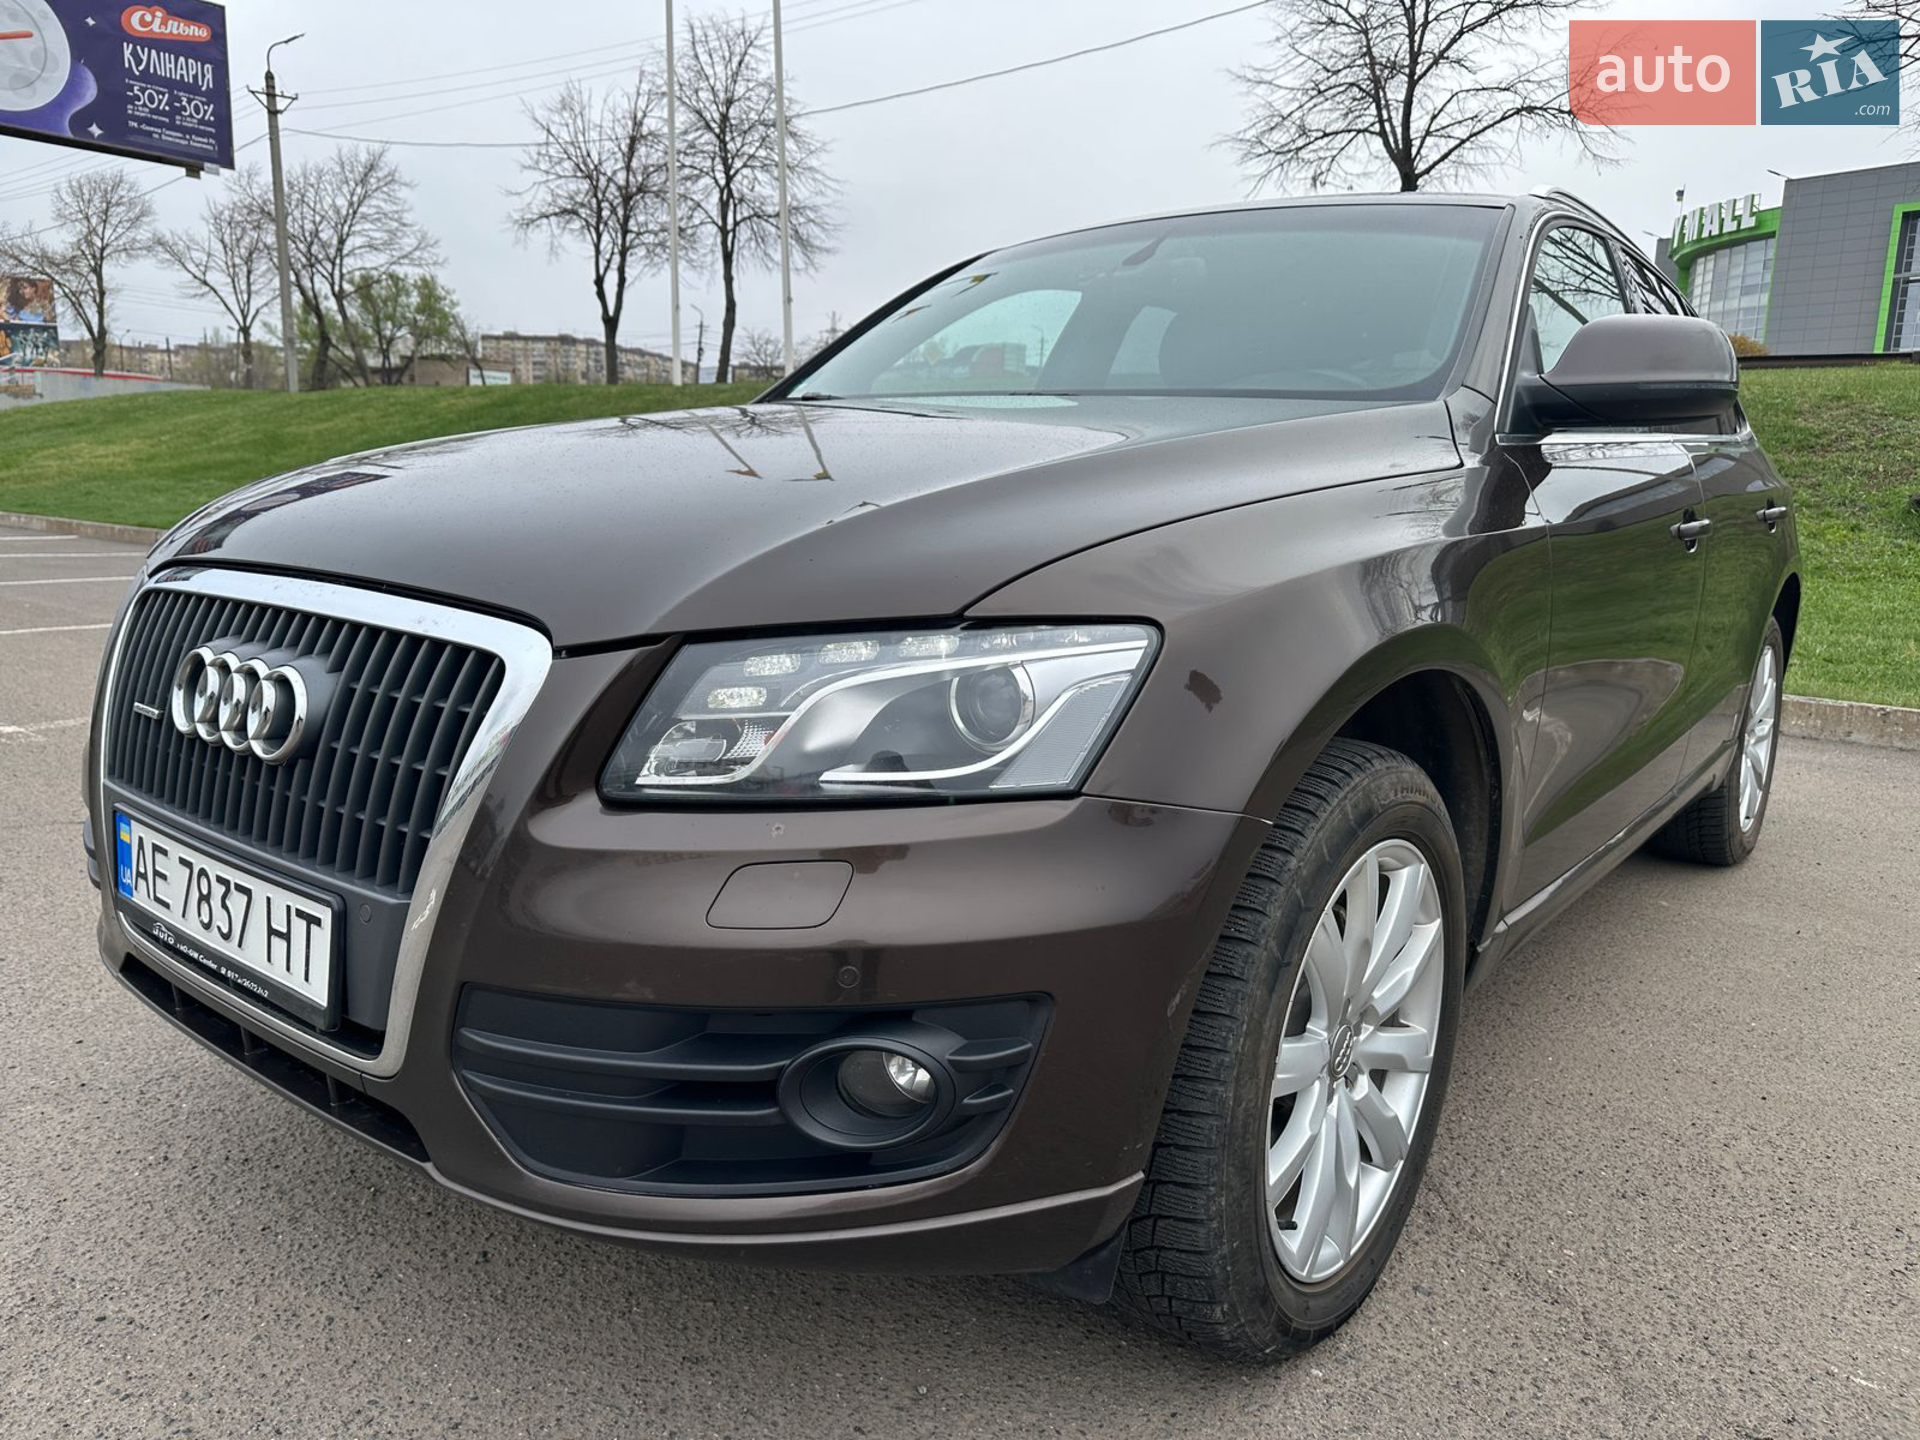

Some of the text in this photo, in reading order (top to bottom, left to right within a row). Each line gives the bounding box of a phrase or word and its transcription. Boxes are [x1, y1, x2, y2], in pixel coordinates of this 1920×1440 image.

[130, 10, 208, 37] Сільпо
[123, 41, 214, 91] КУЛІНАРІЯ
[126, 85, 170, 111] -50%
[173, 96, 215, 122] -30%
[120, 863, 133, 887] UA
[134, 834, 323, 983] AE 7837 HT
